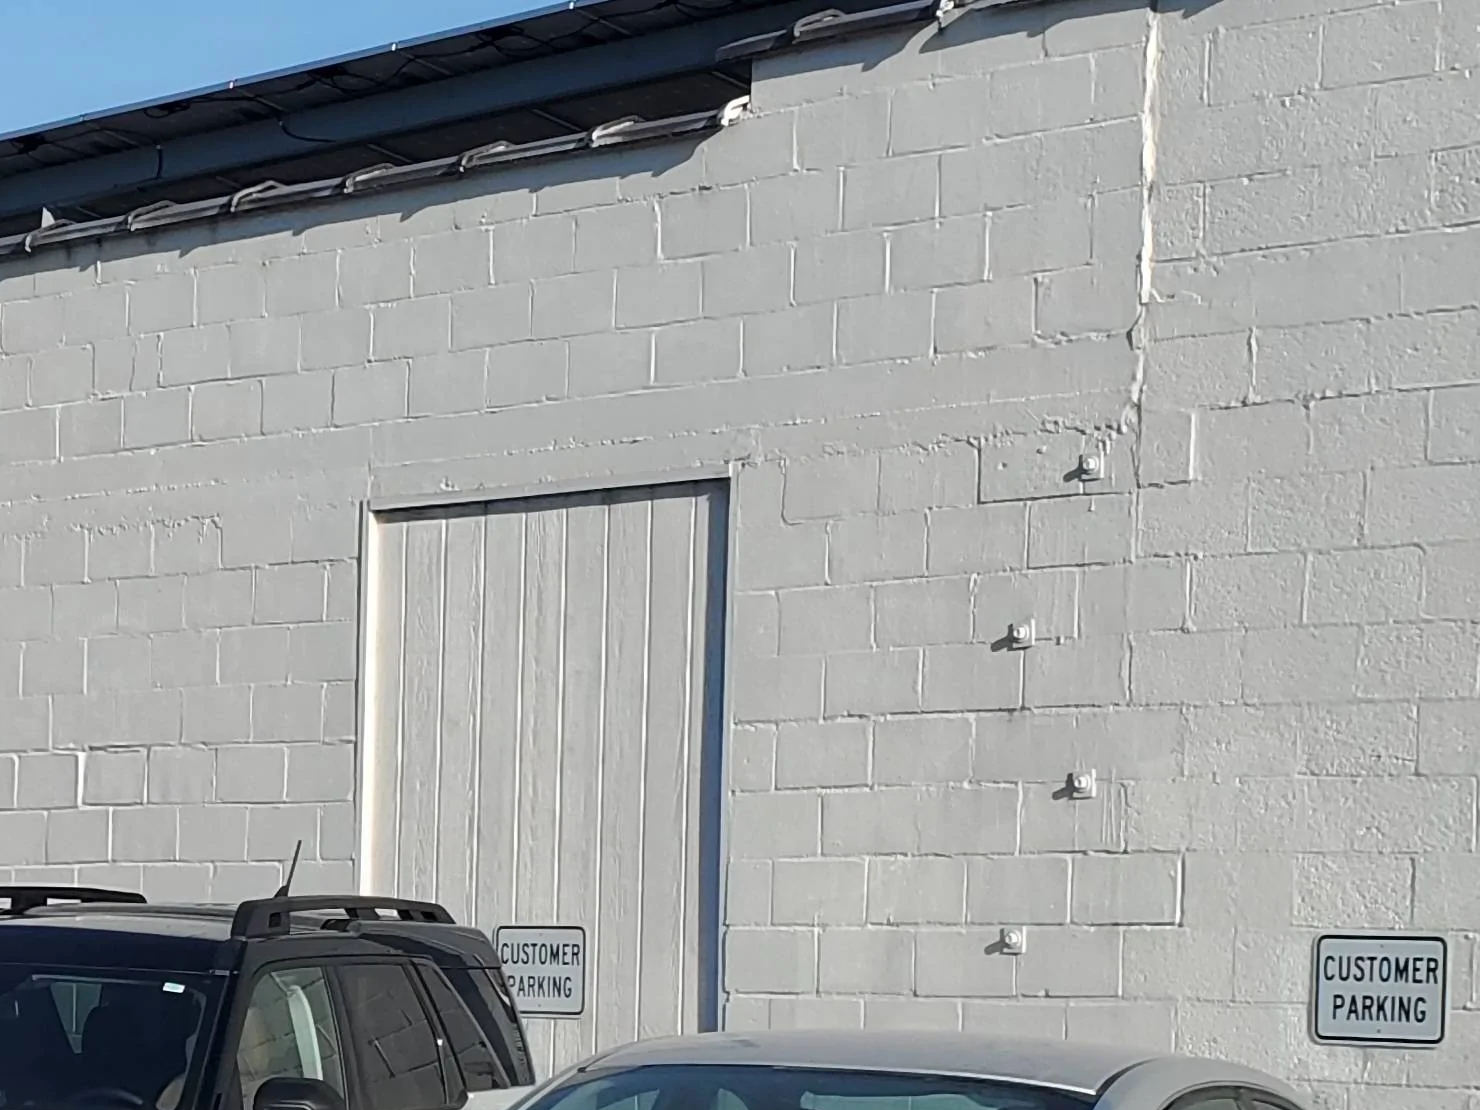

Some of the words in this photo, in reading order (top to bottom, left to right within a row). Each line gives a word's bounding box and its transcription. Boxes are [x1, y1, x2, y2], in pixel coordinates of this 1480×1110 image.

[501, 943, 580, 966] CUSTOMER
[1323, 955, 1439, 985] CUSTOMER
[507, 975, 573, 998] PARKING
[1332, 994, 1427, 1023] PARKING
